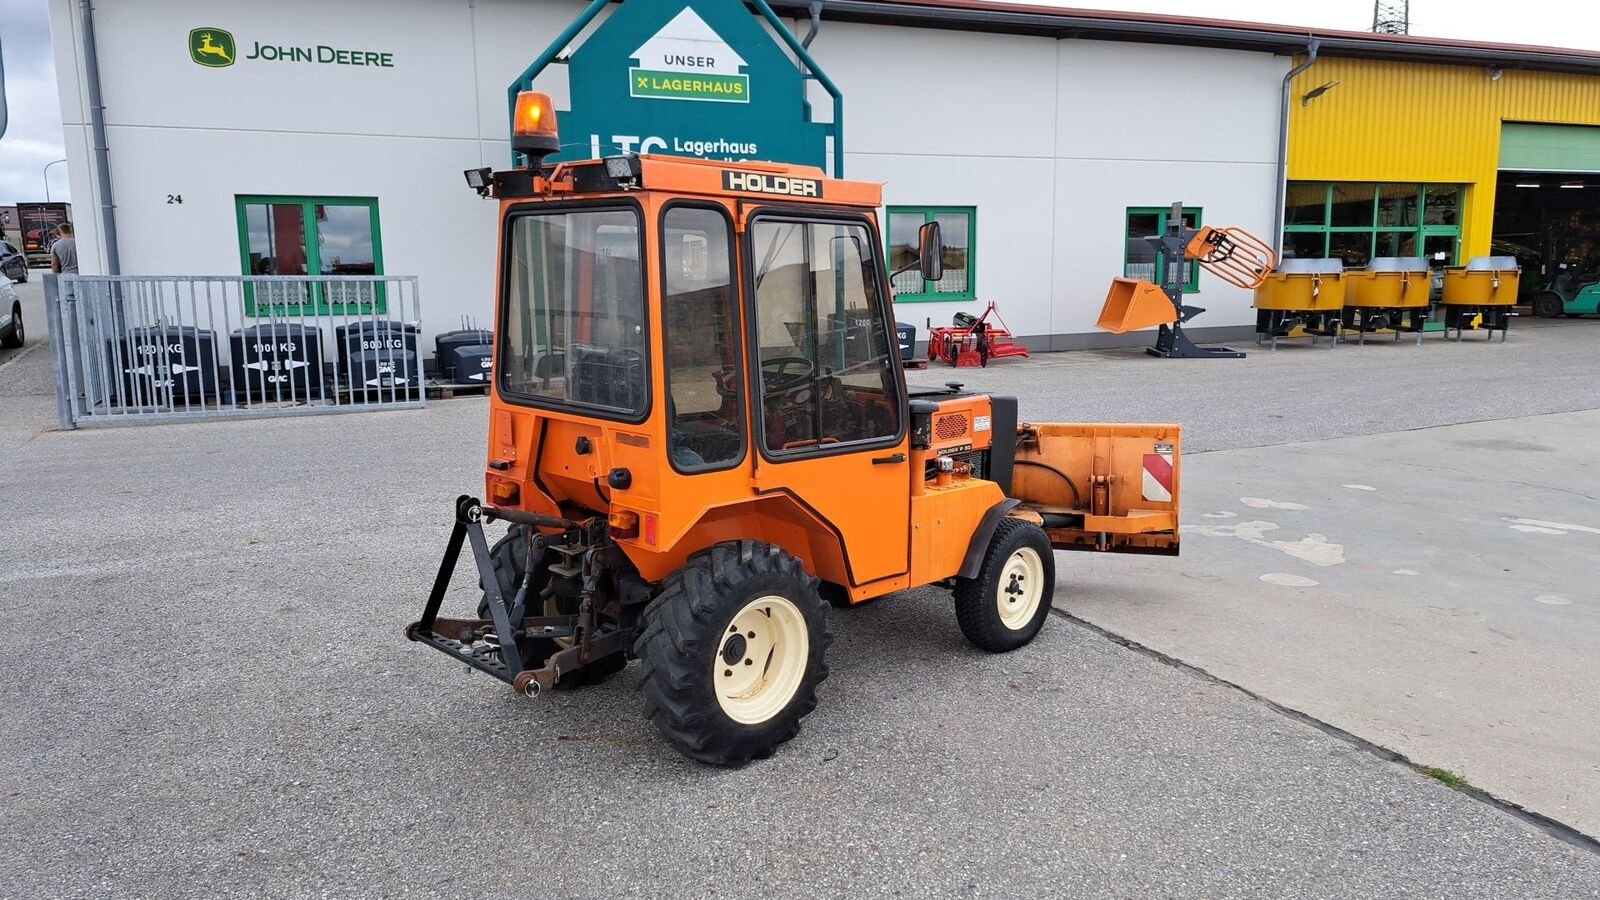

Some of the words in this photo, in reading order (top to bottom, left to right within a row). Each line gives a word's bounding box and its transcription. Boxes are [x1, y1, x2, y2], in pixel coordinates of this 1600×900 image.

[246, 41, 312, 62] JOHN
[317, 45, 394, 67] DEERE
[664, 54, 715, 68] UNSER
[652, 78, 743, 94] LAGERHAUS
[674, 137, 757, 155] Lagerhaus
[729, 171, 817, 197] HOLDER
[167, 194, 183, 204] 24
[280, 342, 296, 352] KG
[363, 340, 382, 349] 800
[386, 339, 402, 348] KG
